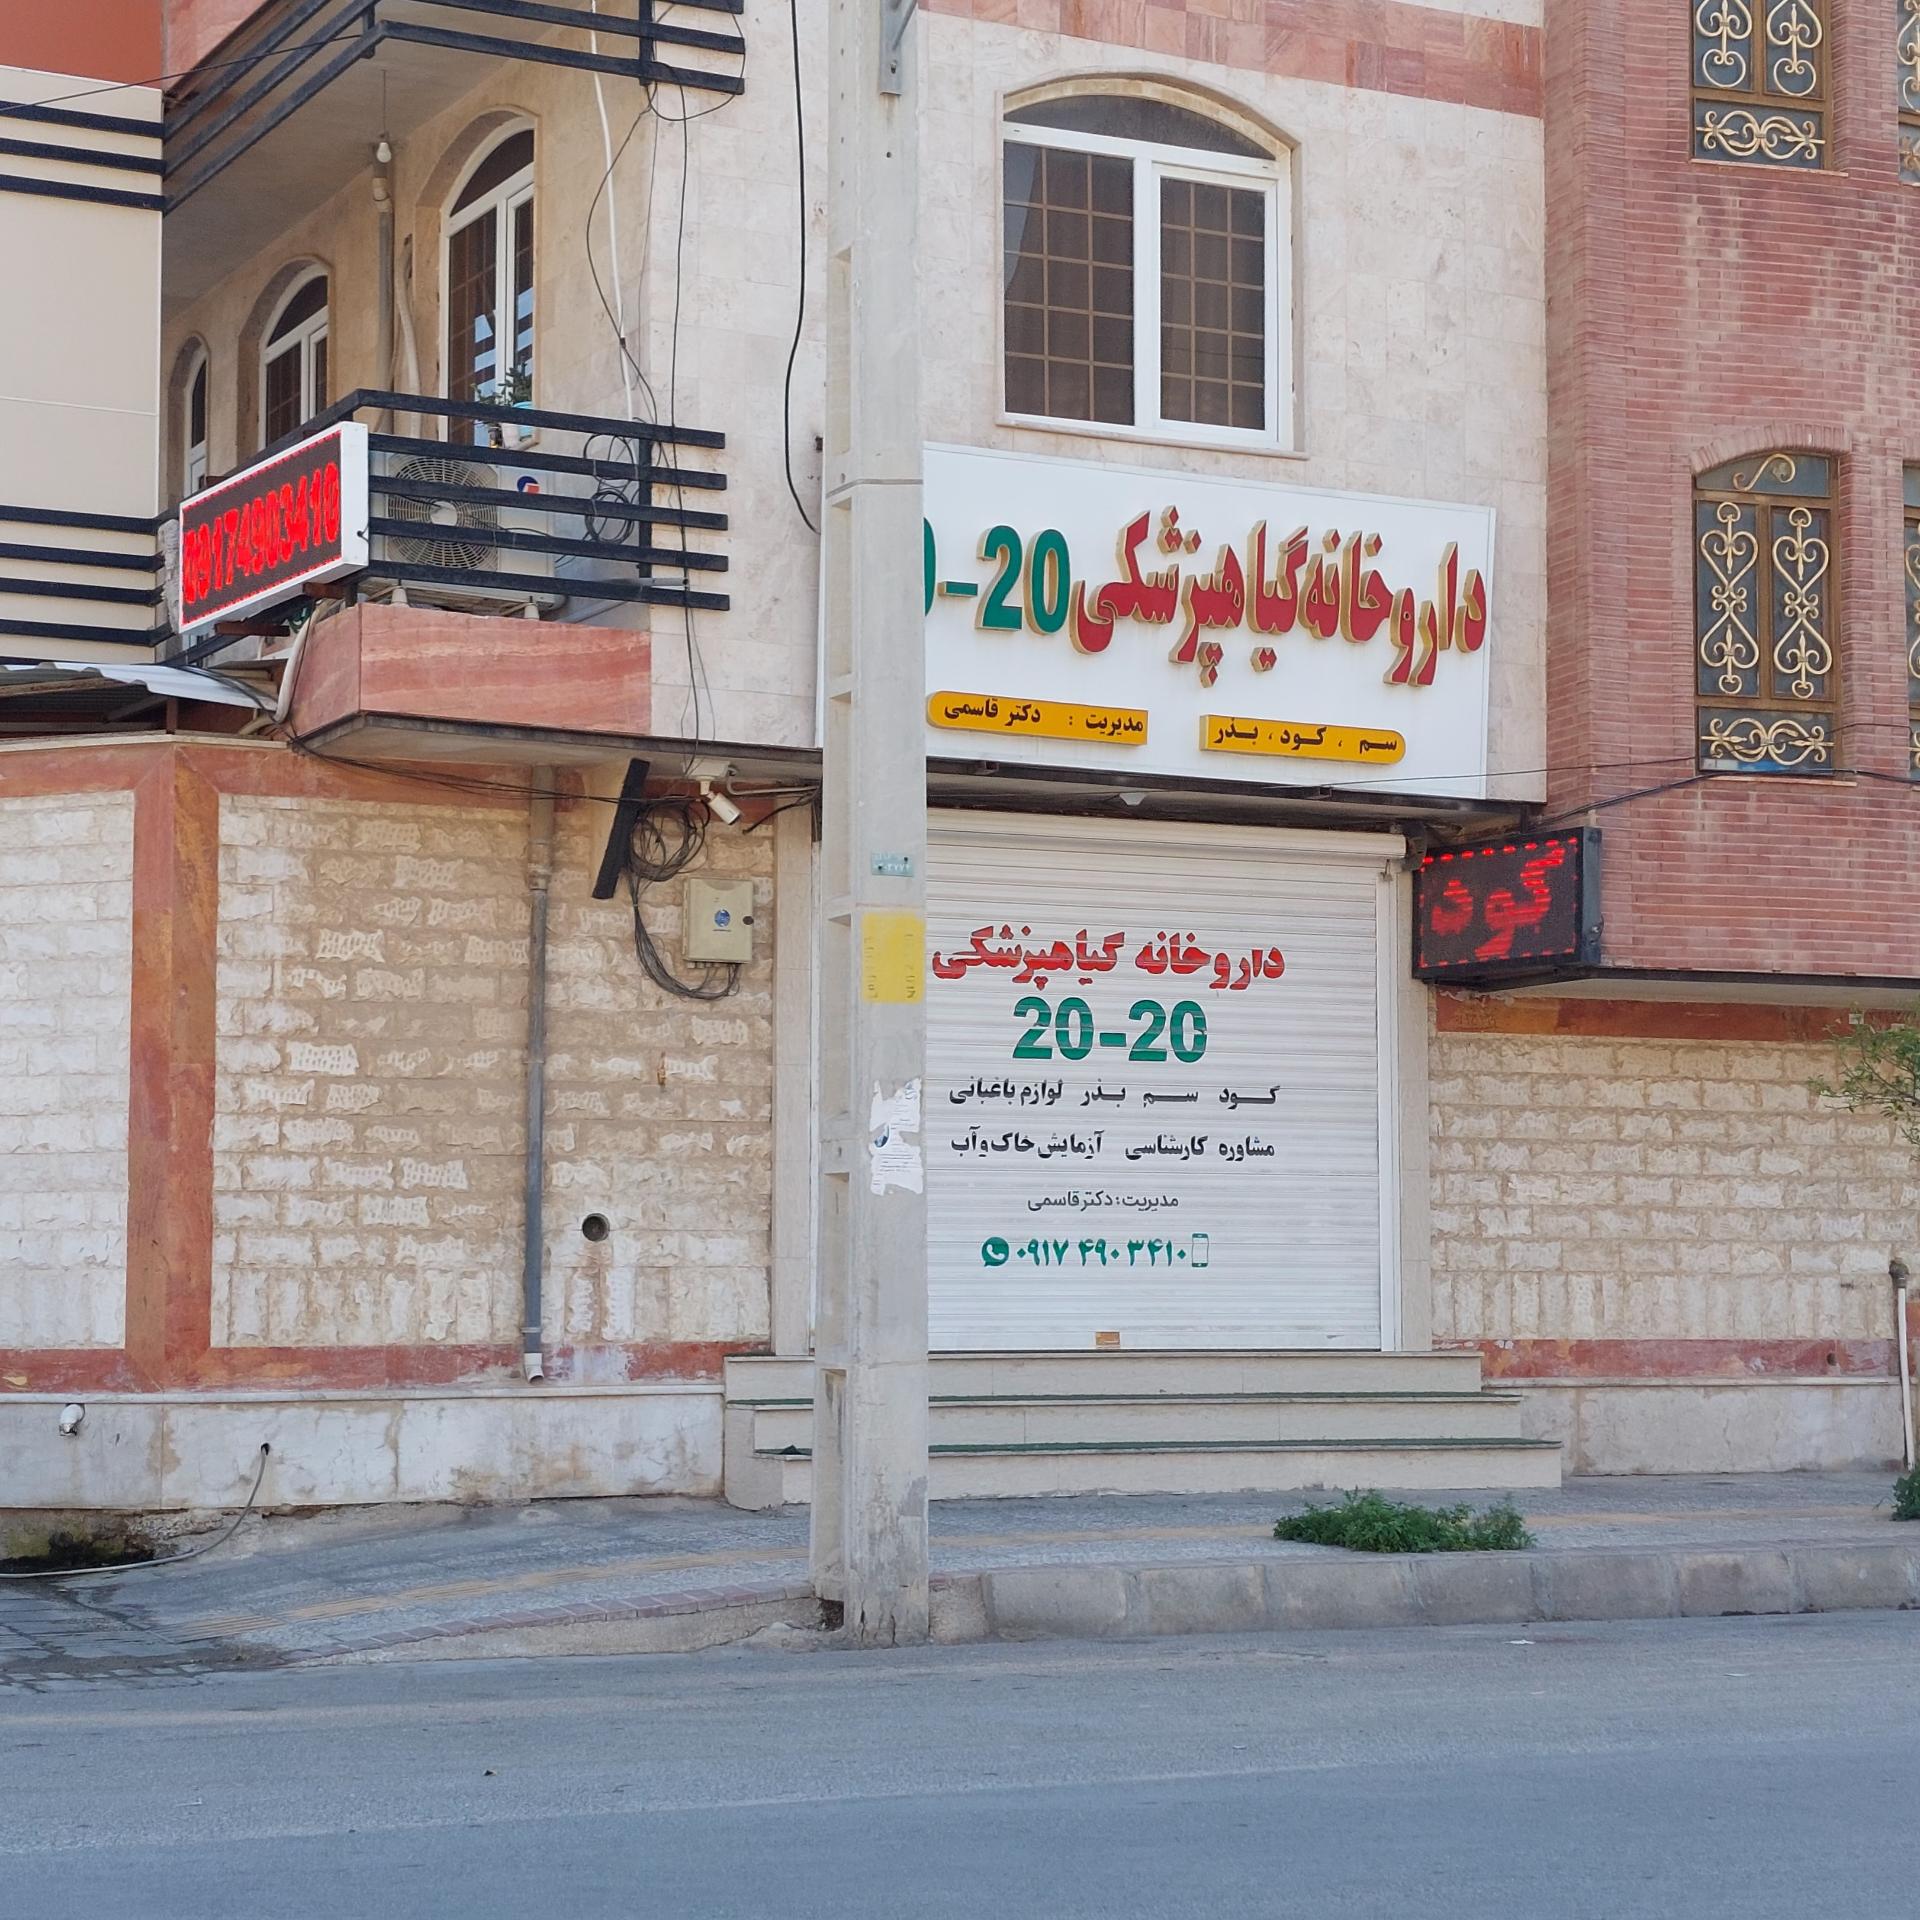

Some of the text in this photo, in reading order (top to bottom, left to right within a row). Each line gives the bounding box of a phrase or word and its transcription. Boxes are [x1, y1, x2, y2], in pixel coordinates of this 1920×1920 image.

[183, 461, 341, 604] 09174903410
[1298, 527, 1488, 688] داروخانه
[944, 698, 998, 720] قاسمی
[1004, 704, 1041, 726] دکتر
[1086, 712, 1144, 737] مدیریت
[1213, 717, 1259, 745] بذر
[1280, 726, 1327, 751] کود
[1359, 736, 1398, 754] سم
[1432, 847, 1566, 959] کود
[1135, 931, 1286, 990] داروخانه
[1012, 996, 1208, 1063] 20-20
[949, 1076, 1281, 1110] کود سم بذر لوازم باغبانی
[1038, 1130, 1105, 1160] آزمایش
[1125, 1133, 1208, 1160] کارشناسی
[1219, 1136, 1275, 1162] مشاوره
[1027, 1190, 1080, 1212] قاسمی
[1080, 1190, 1113, 1212] دکتر
